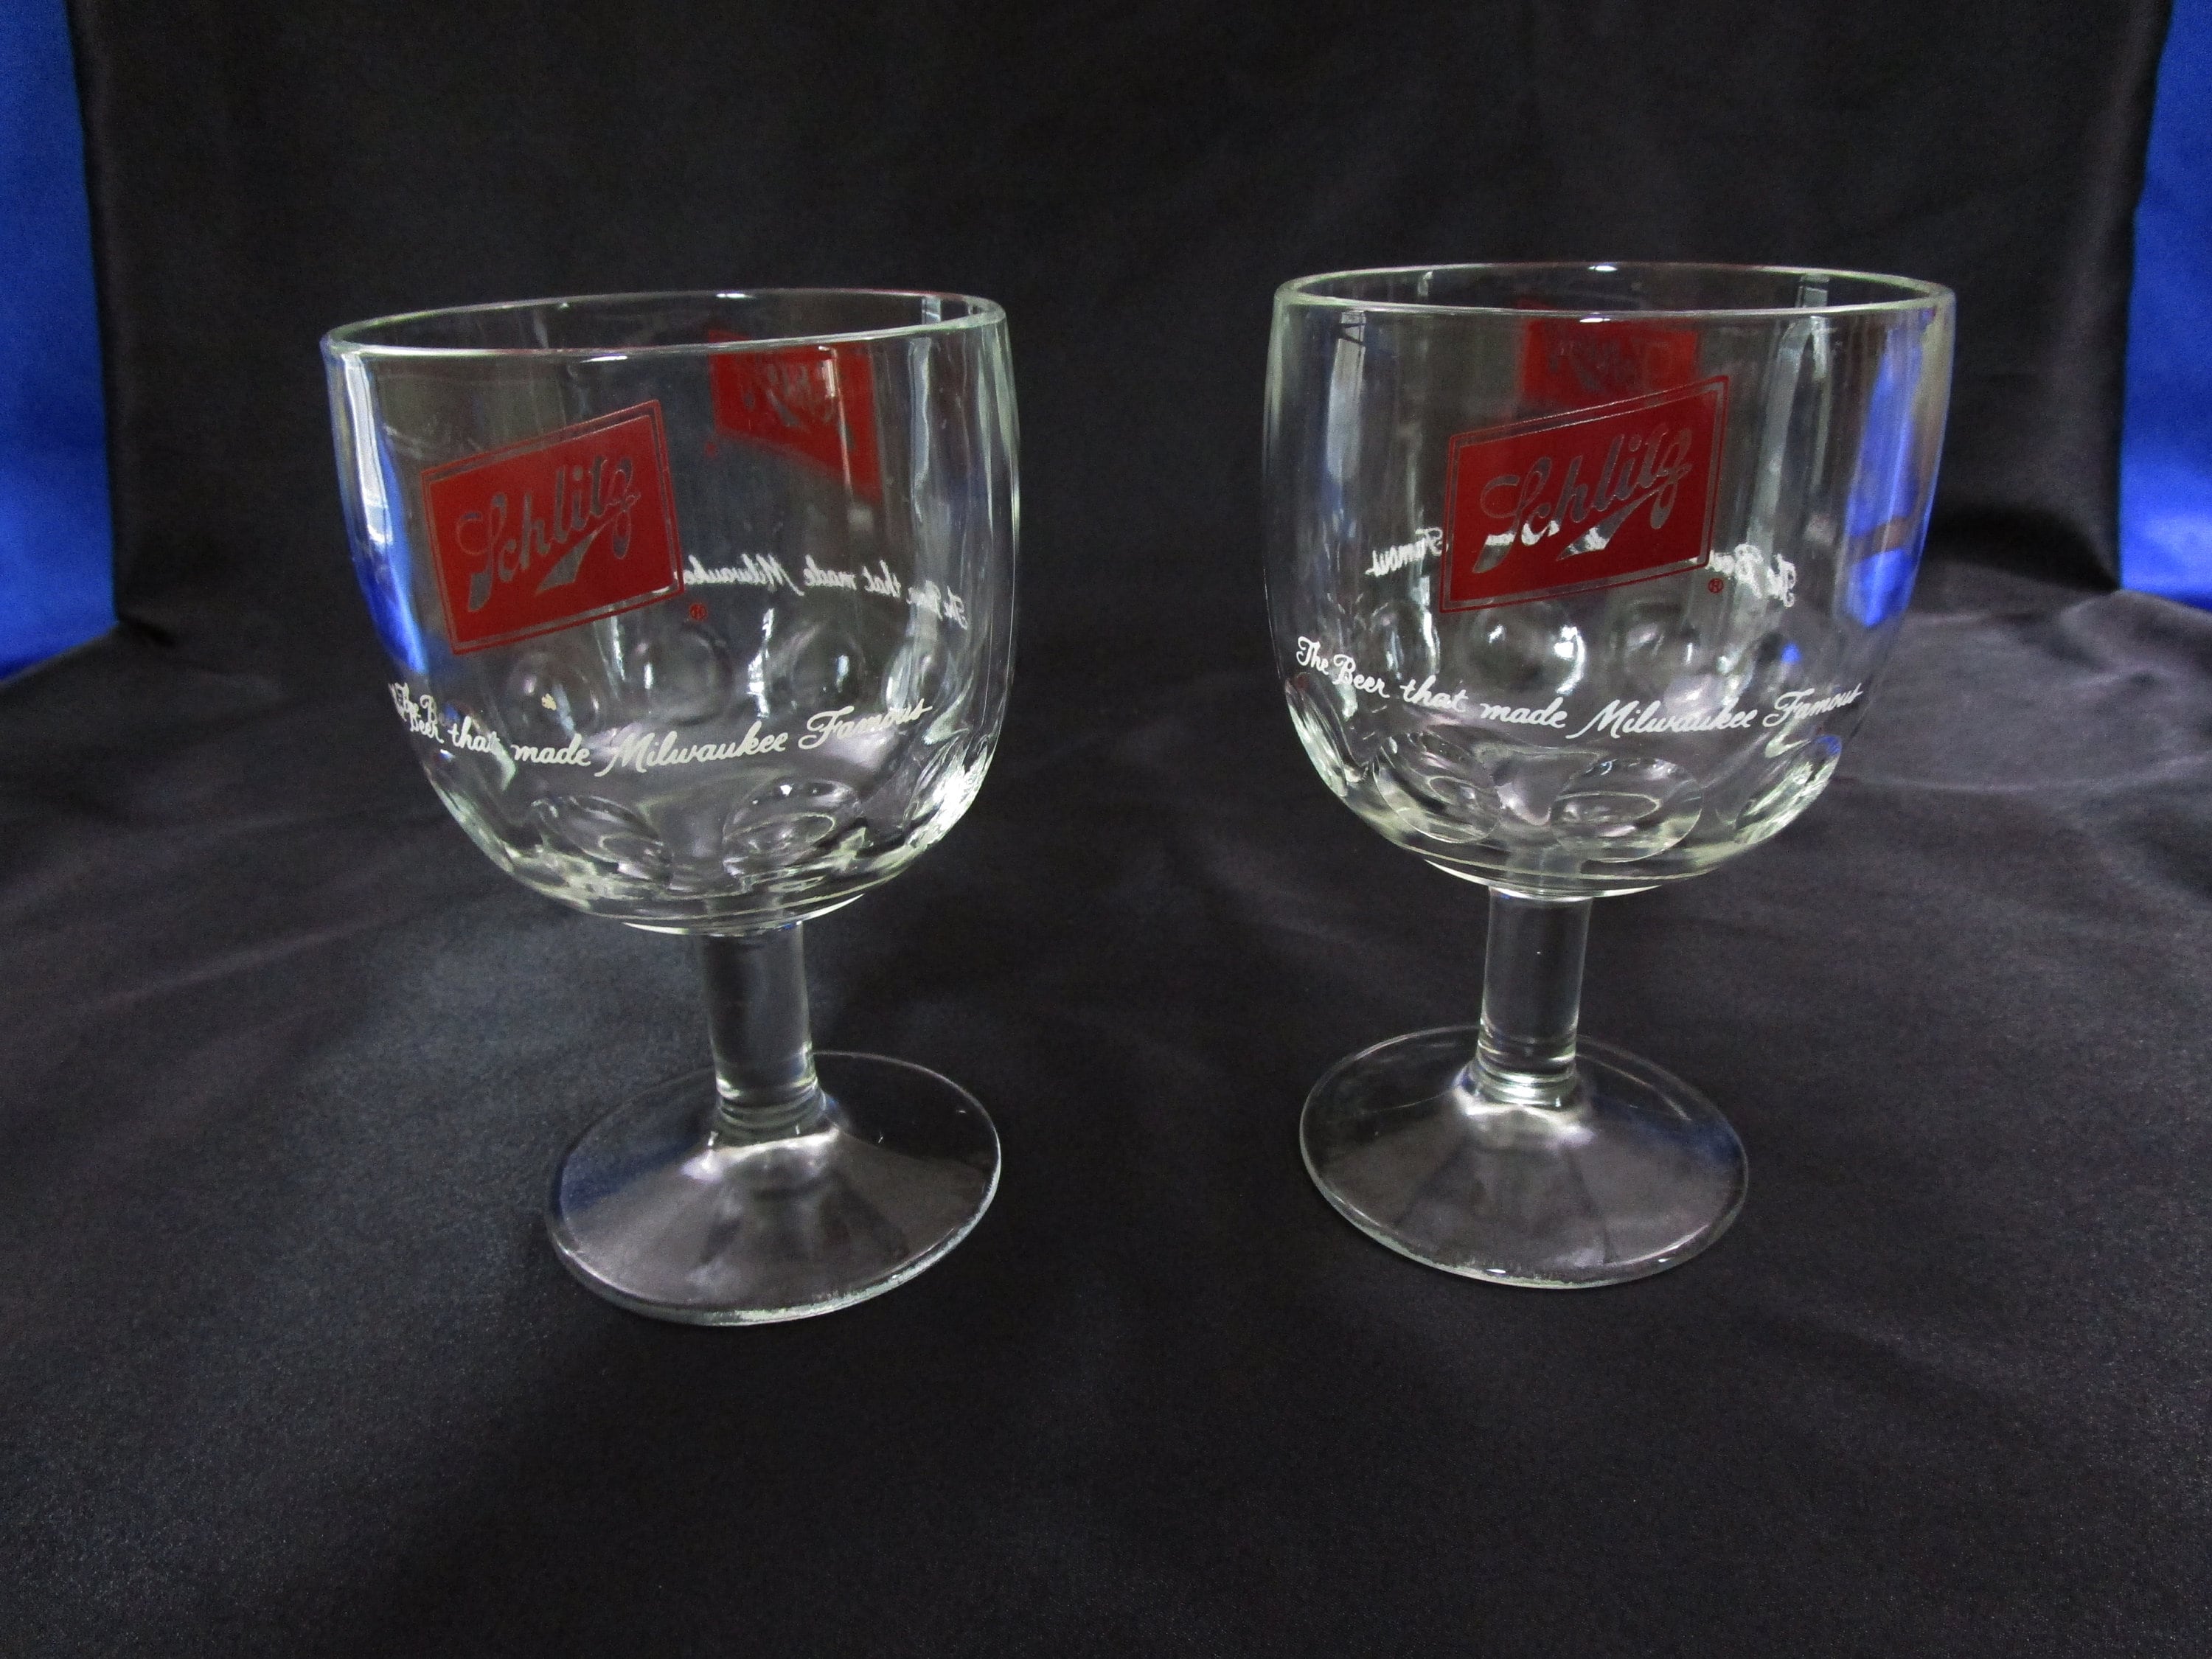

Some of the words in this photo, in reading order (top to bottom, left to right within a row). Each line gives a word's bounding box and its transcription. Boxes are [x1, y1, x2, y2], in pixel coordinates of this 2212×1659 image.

[456, 456, 641, 613] Schlitz
[1472, 423, 1693, 574] Schlitz
[448, 715, 501, 752] that
[510, 734, 591, 767] made
[594, 720, 789, 777] Milwaukee
[798, 698, 933, 750] Famous
[1296, 636, 1329, 675] The
[1332, 654, 1390, 698] Beer
[1400, 675, 1469, 712] that
[1480, 697, 1568, 728] made
[1565, 696, 1758, 739] Milwaukee
[1761, 682, 1863, 728] Famous
